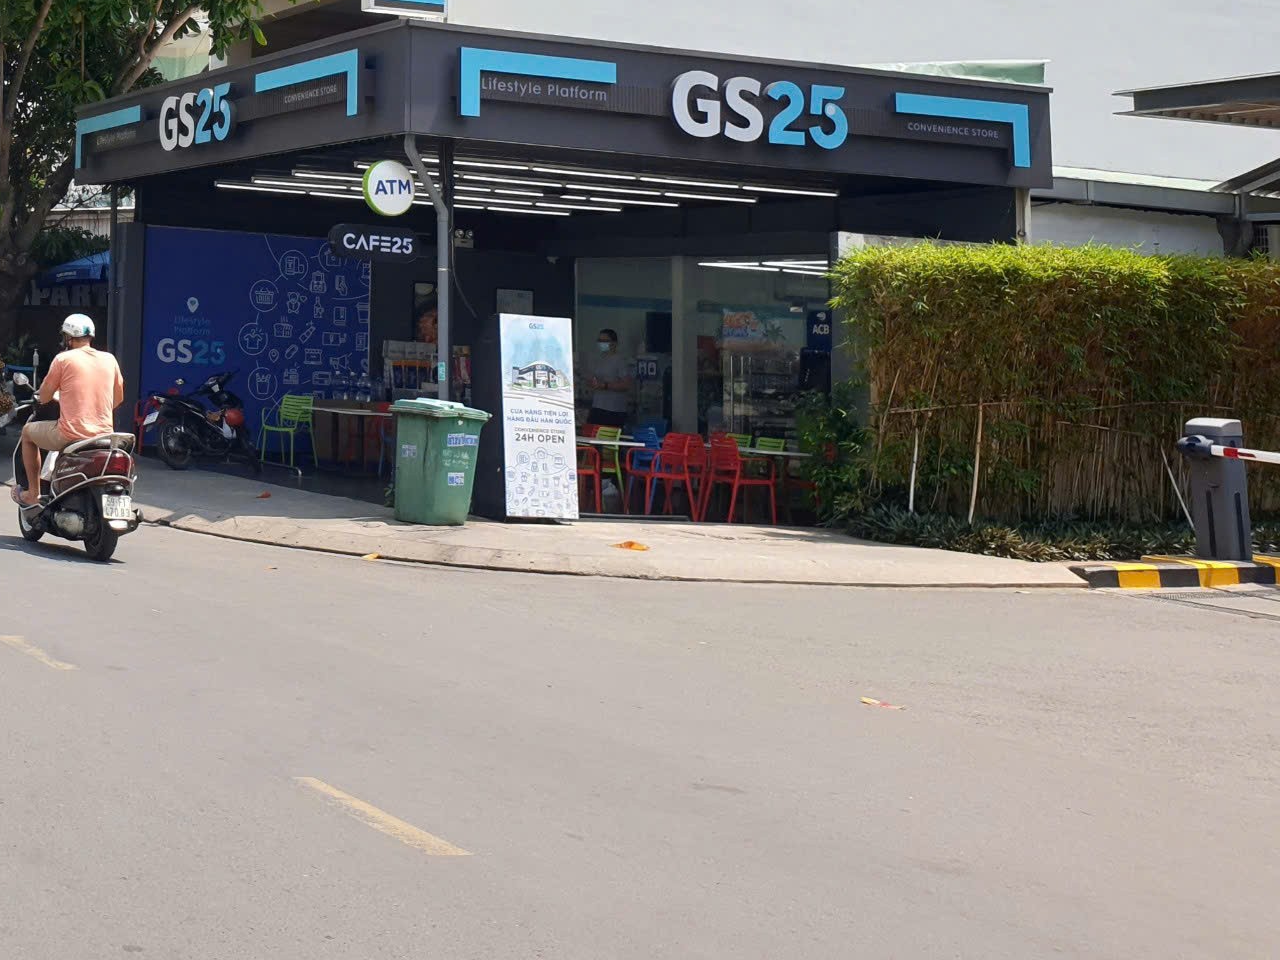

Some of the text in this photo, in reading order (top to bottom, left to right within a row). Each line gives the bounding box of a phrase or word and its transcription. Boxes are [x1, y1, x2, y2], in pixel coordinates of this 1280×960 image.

[320, 84, 337, 97] STORE
[482, 77, 607, 101] Lifestyle Platform
[159, 82, 232, 152] GS25
[671, 69, 850, 151] GS25
[971, 128, 1000, 139] STORE
[375, 179, 412, 195] ATM
[342, 233, 413, 255] CAFE25
[812, 323, 830, 336] ACB
[156, 337, 227, 365] GS25
[515, 433, 565, 444] 24H OPEN
